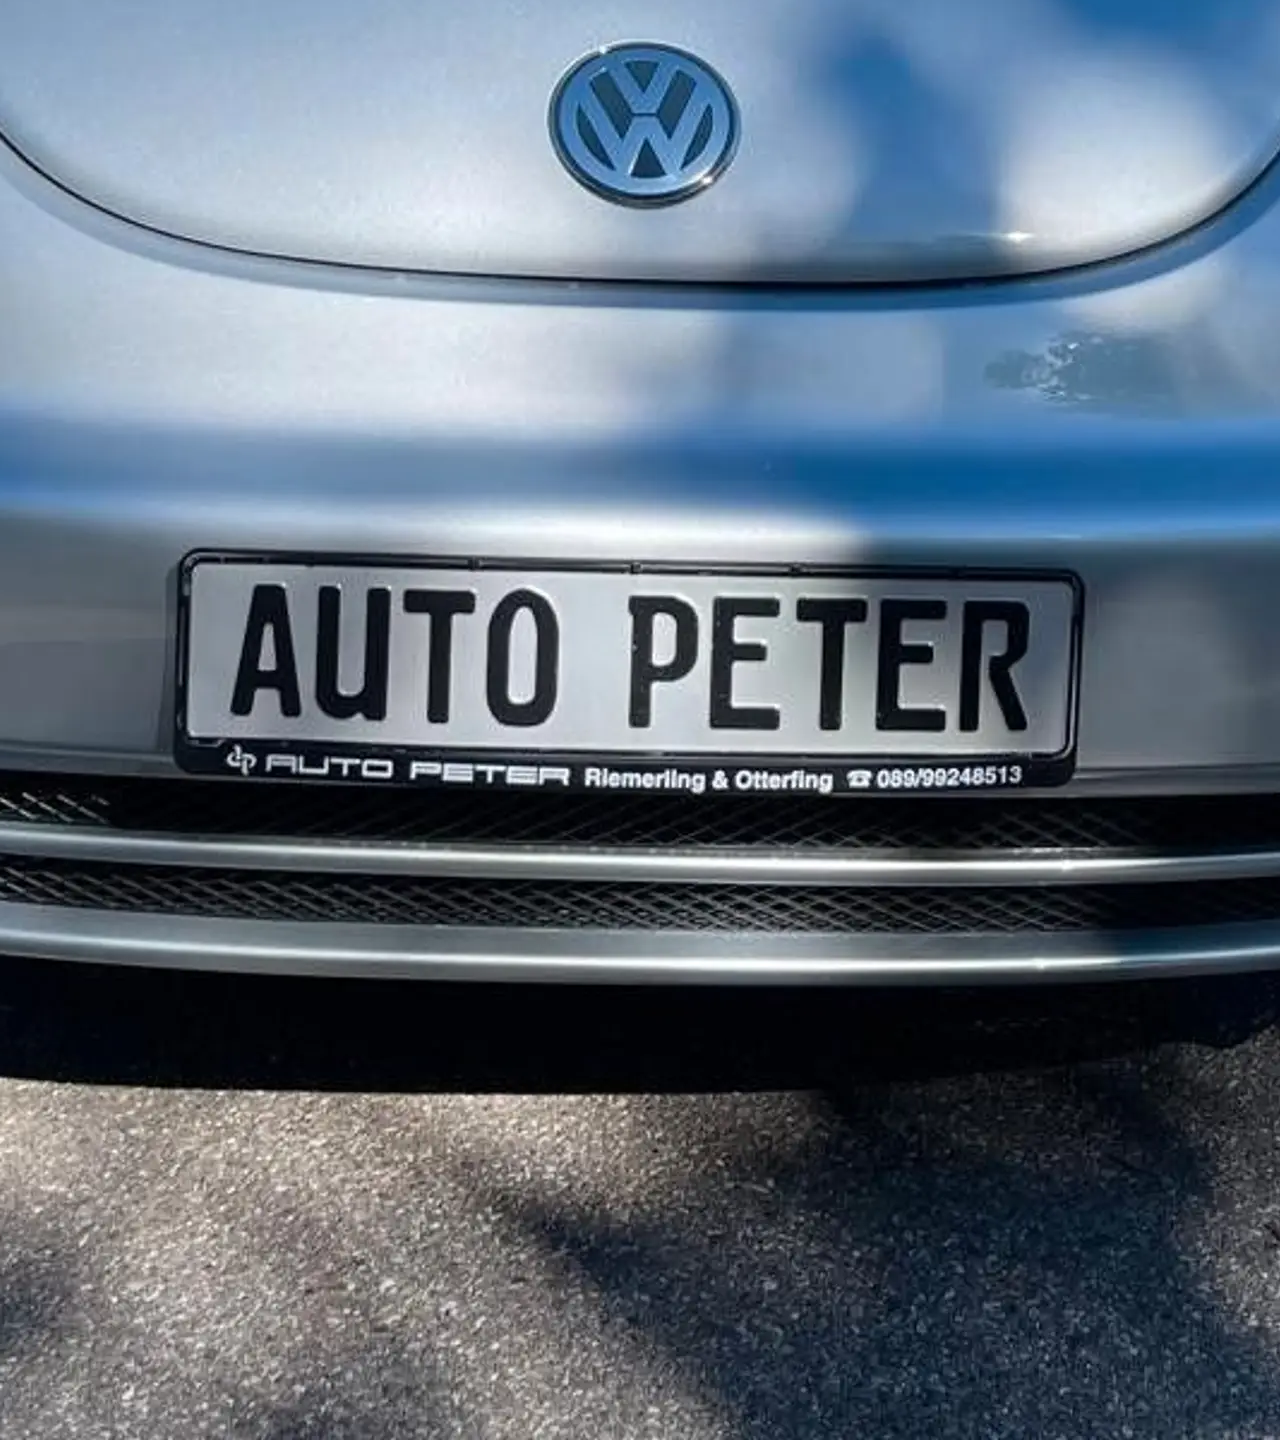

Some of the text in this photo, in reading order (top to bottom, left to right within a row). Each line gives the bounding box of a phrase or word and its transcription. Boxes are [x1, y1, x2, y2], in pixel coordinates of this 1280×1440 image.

[229, 583, 1031, 733] AUTO PETER
[264, 753, 394, 779] AUTO
[409, 759, 572, 787] PETER
[583, 767, 707, 794] Riemerling
[712, 769, 729, 790] &
[734, 768, 834, 795] Otterfing
[876, 766, 1022, 789] 089/99248513
